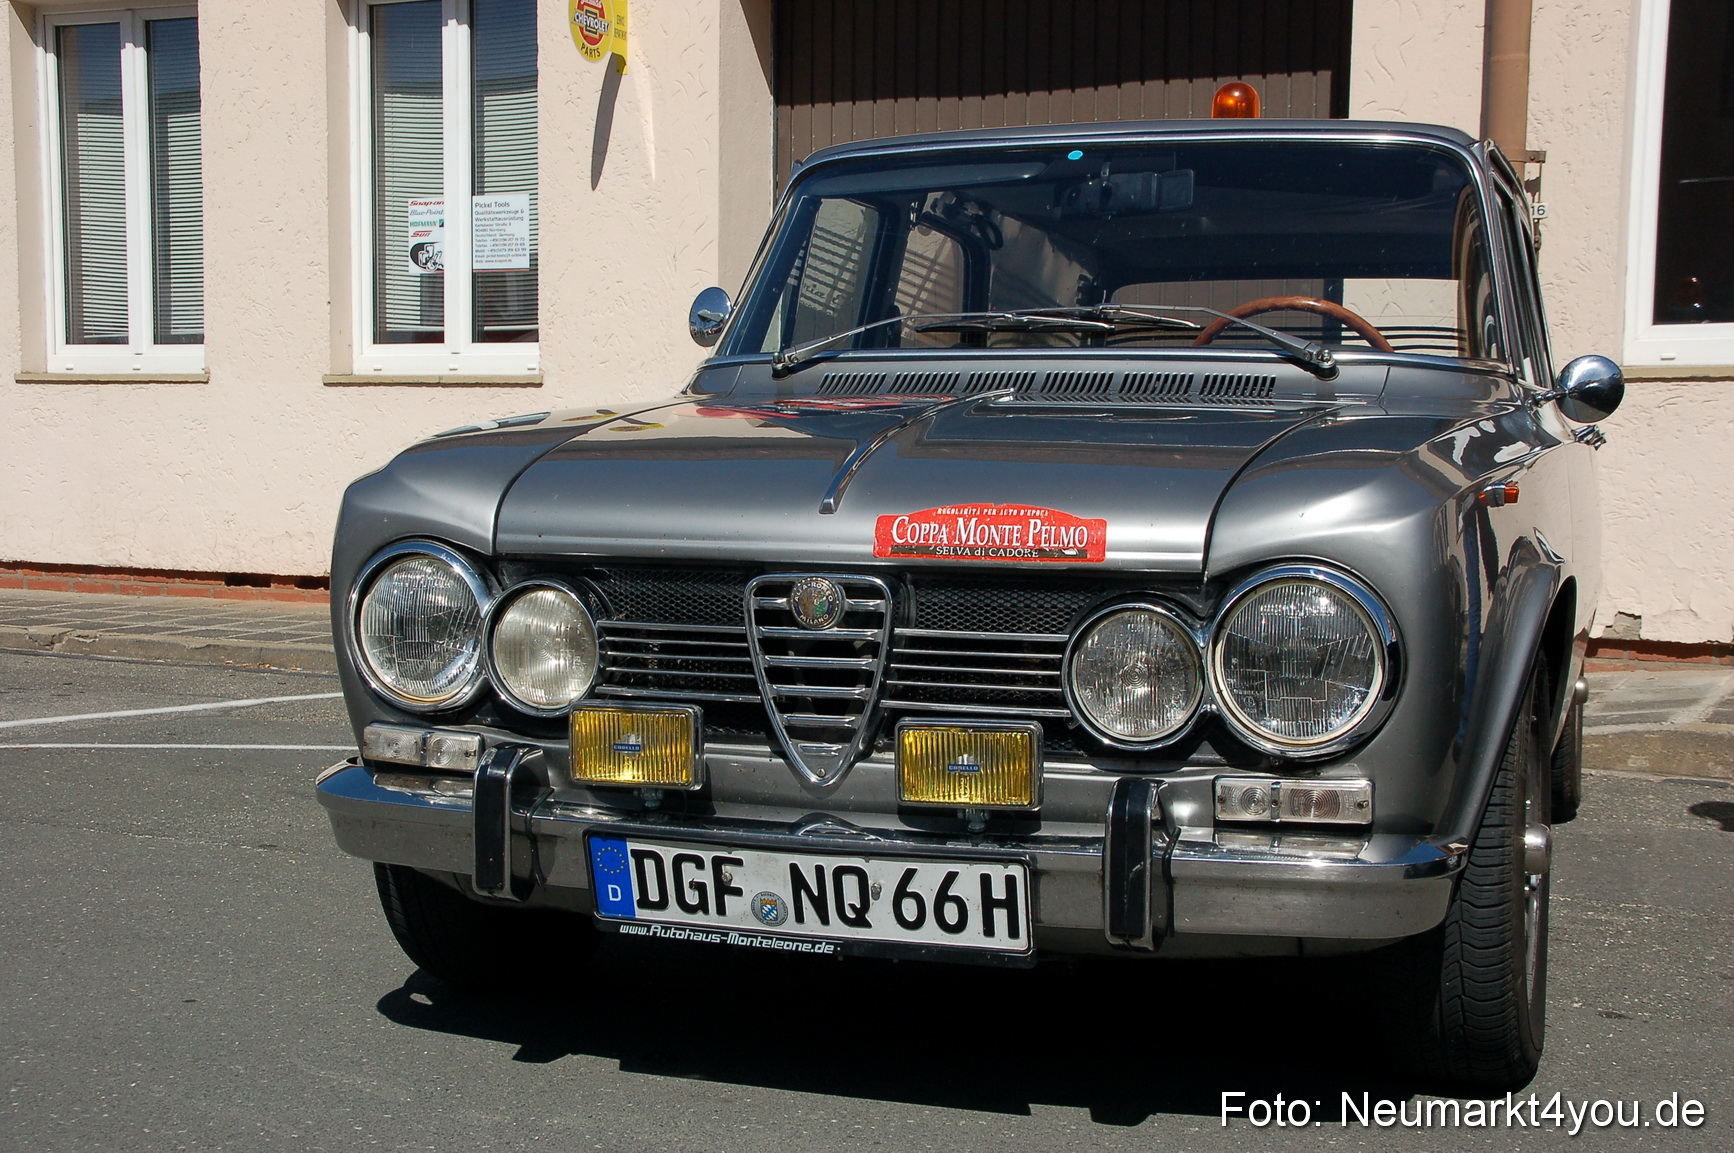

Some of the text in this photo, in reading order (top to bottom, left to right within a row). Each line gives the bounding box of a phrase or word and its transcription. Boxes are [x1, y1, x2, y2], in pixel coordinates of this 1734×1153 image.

[574, 12, 610, 33] CHEVROLET
[581, 42, 601, 58] PARTS
[1530, 205, 1546, 216] 16
[983, 508, 997, 516] PER
[891, 516, 1088, 548] COPPA MONTE PELMO
[936, 546, 1040, 558] SELVA di CADORE
[811, 582, 834, 602] ROMEO
[799, 614, 829, 625] MILANO
[608, 883, 622, 902] D
[629, 848, 746, 917] DGF
[788, 862, 874, 929] NQ
[619, 923, 834, 954] www.Autohaus-Monteleone.de
